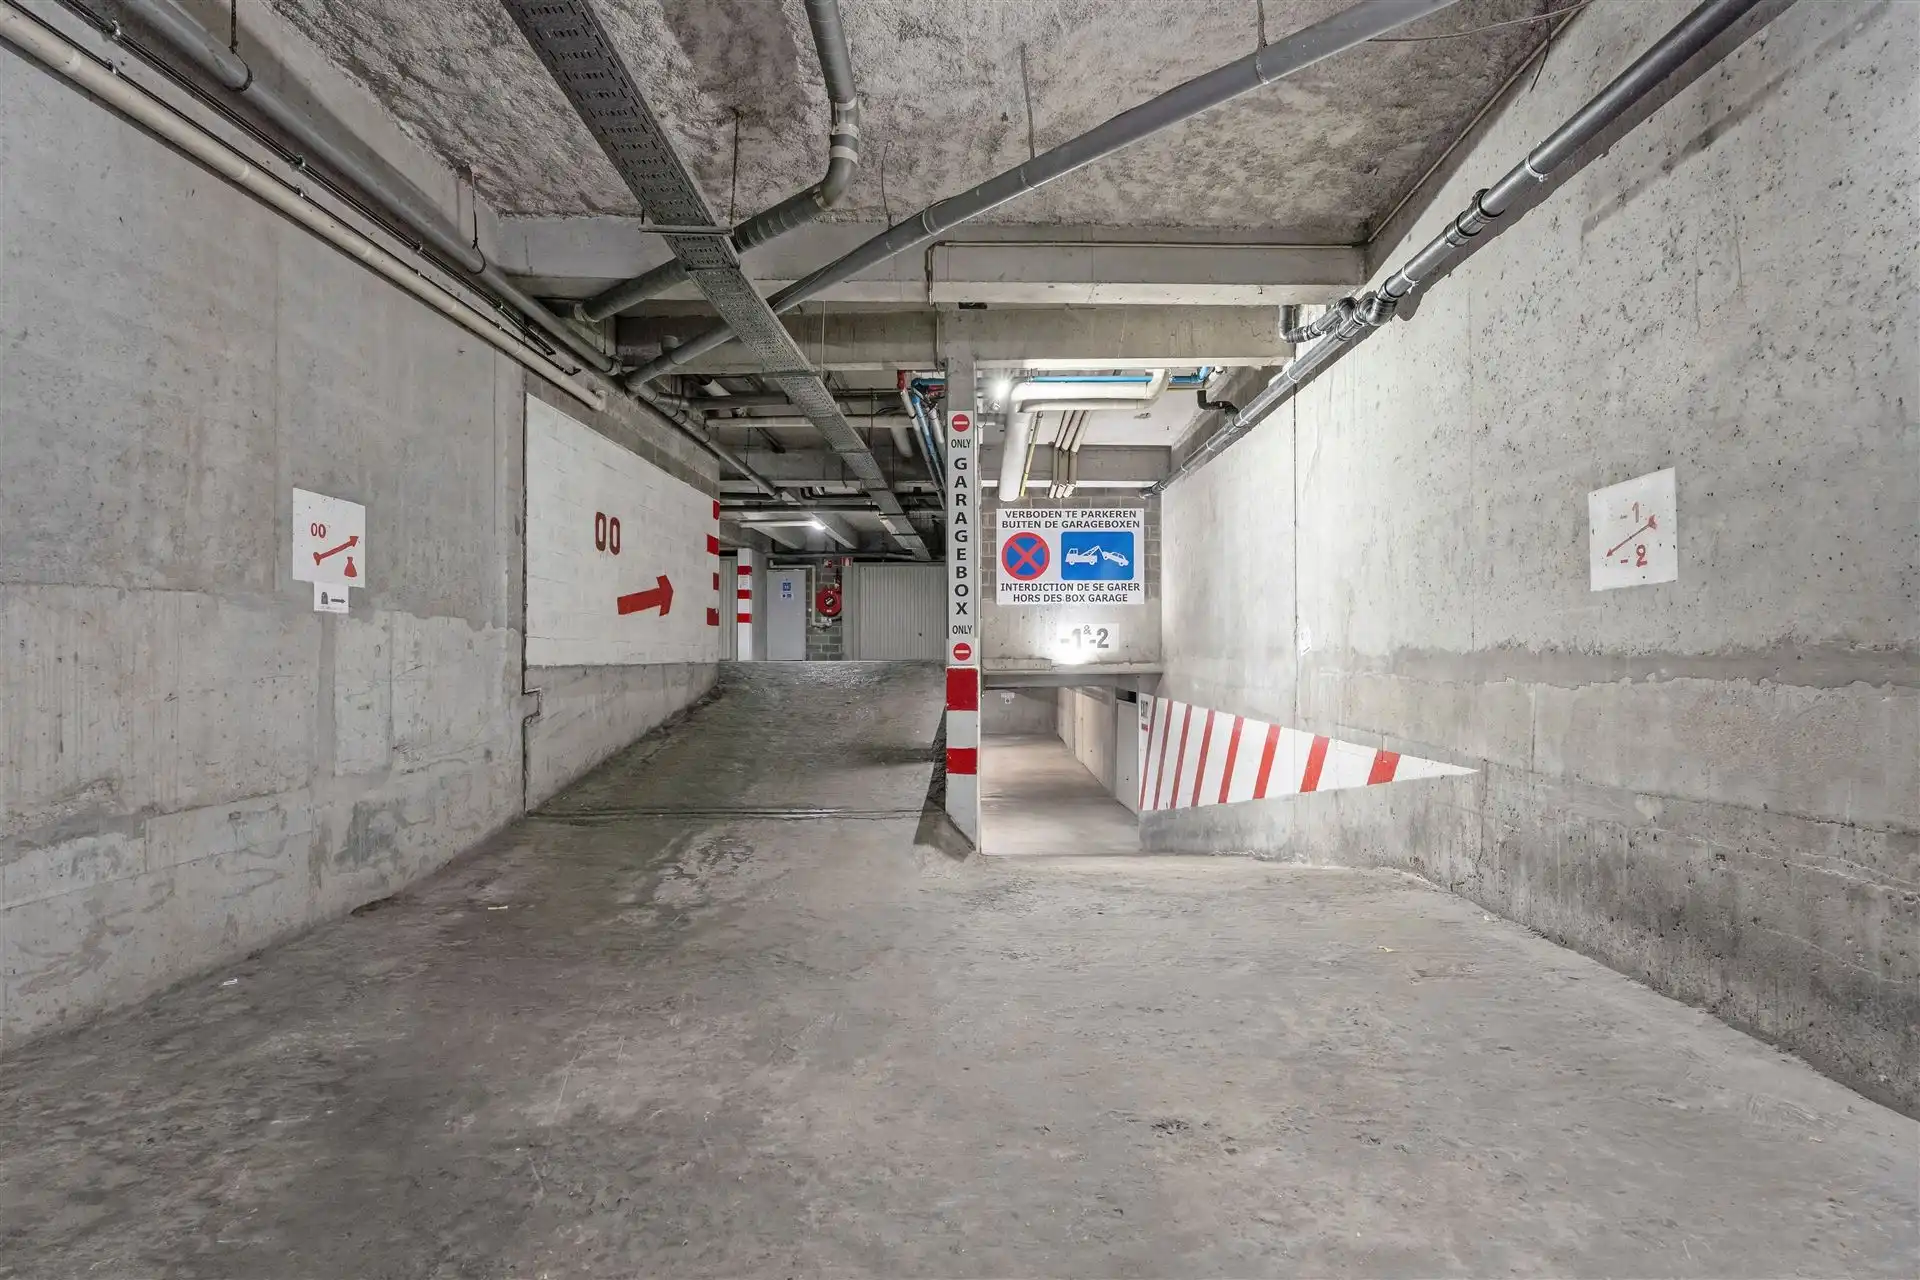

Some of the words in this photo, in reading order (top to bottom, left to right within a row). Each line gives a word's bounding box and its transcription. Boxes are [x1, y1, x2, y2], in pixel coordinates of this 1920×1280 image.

[951, 439, 971, 448] ONLY
[1005, 510, 1062, 518] VERBODEN
[1065, 510, 1078, 518] TE
[1081, 510, 1137, 518] PARKEREN
[1002, 520, 1041, 529] BUITEN
[1045, 520, 1058, 529] DE
[1061, 520, 1140, 529] GARAGEBOXEN
[311, 522, 326, 539] 00
[953, 457, 969, 615] GARAGEBOX
[1001, 583, 1074, 591] INTERDICTION
[1077, 583, 1090, 591] DE
[1092, 583, 1105, 591] SE
[1107, 583, 1140, 591] GARER
[1013, 594, 1041, 602] HORS
[1043, 594, 1062, 602] DES
[1065, 594, 1085, 602] BOX
[1088, 594, 1128, 602] GARAGE
[952, 625, 973, 635] ONLY
